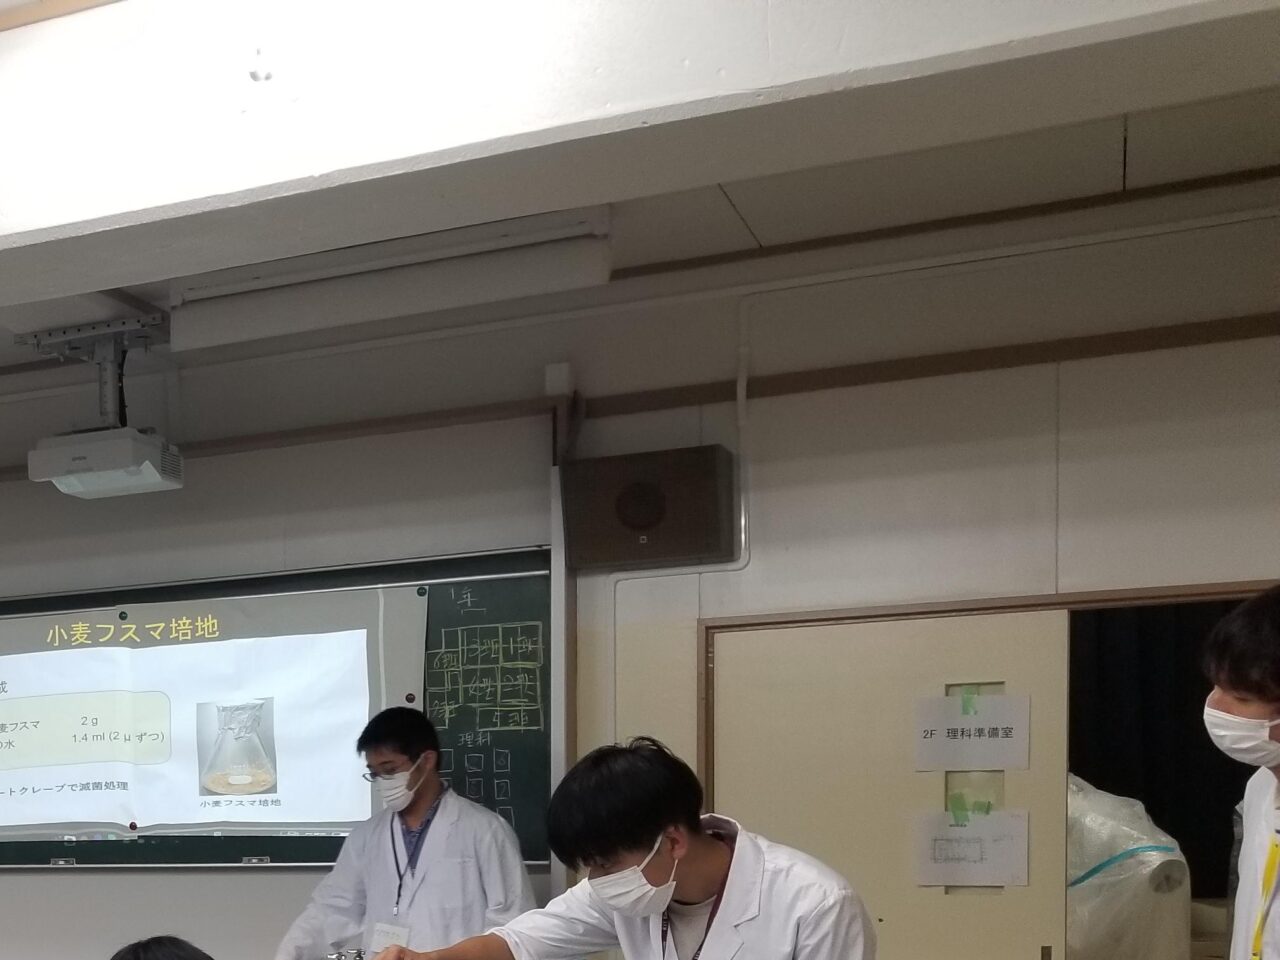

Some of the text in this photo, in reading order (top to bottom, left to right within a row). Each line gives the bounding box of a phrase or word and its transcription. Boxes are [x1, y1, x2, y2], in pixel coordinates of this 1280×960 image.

[46, 613, 219, 647] 小麦フスマ培地
[81, 716, 98, 726] 2 g
[72, 733, 88, 743] 1.4
[92, 732, 105, 742] ml
[457, 731, 491, 746] 理科
[923, 726, 1014, 740] 2F 理科準備室
[199, 798, 282, 808] 小麦フスマ培地
